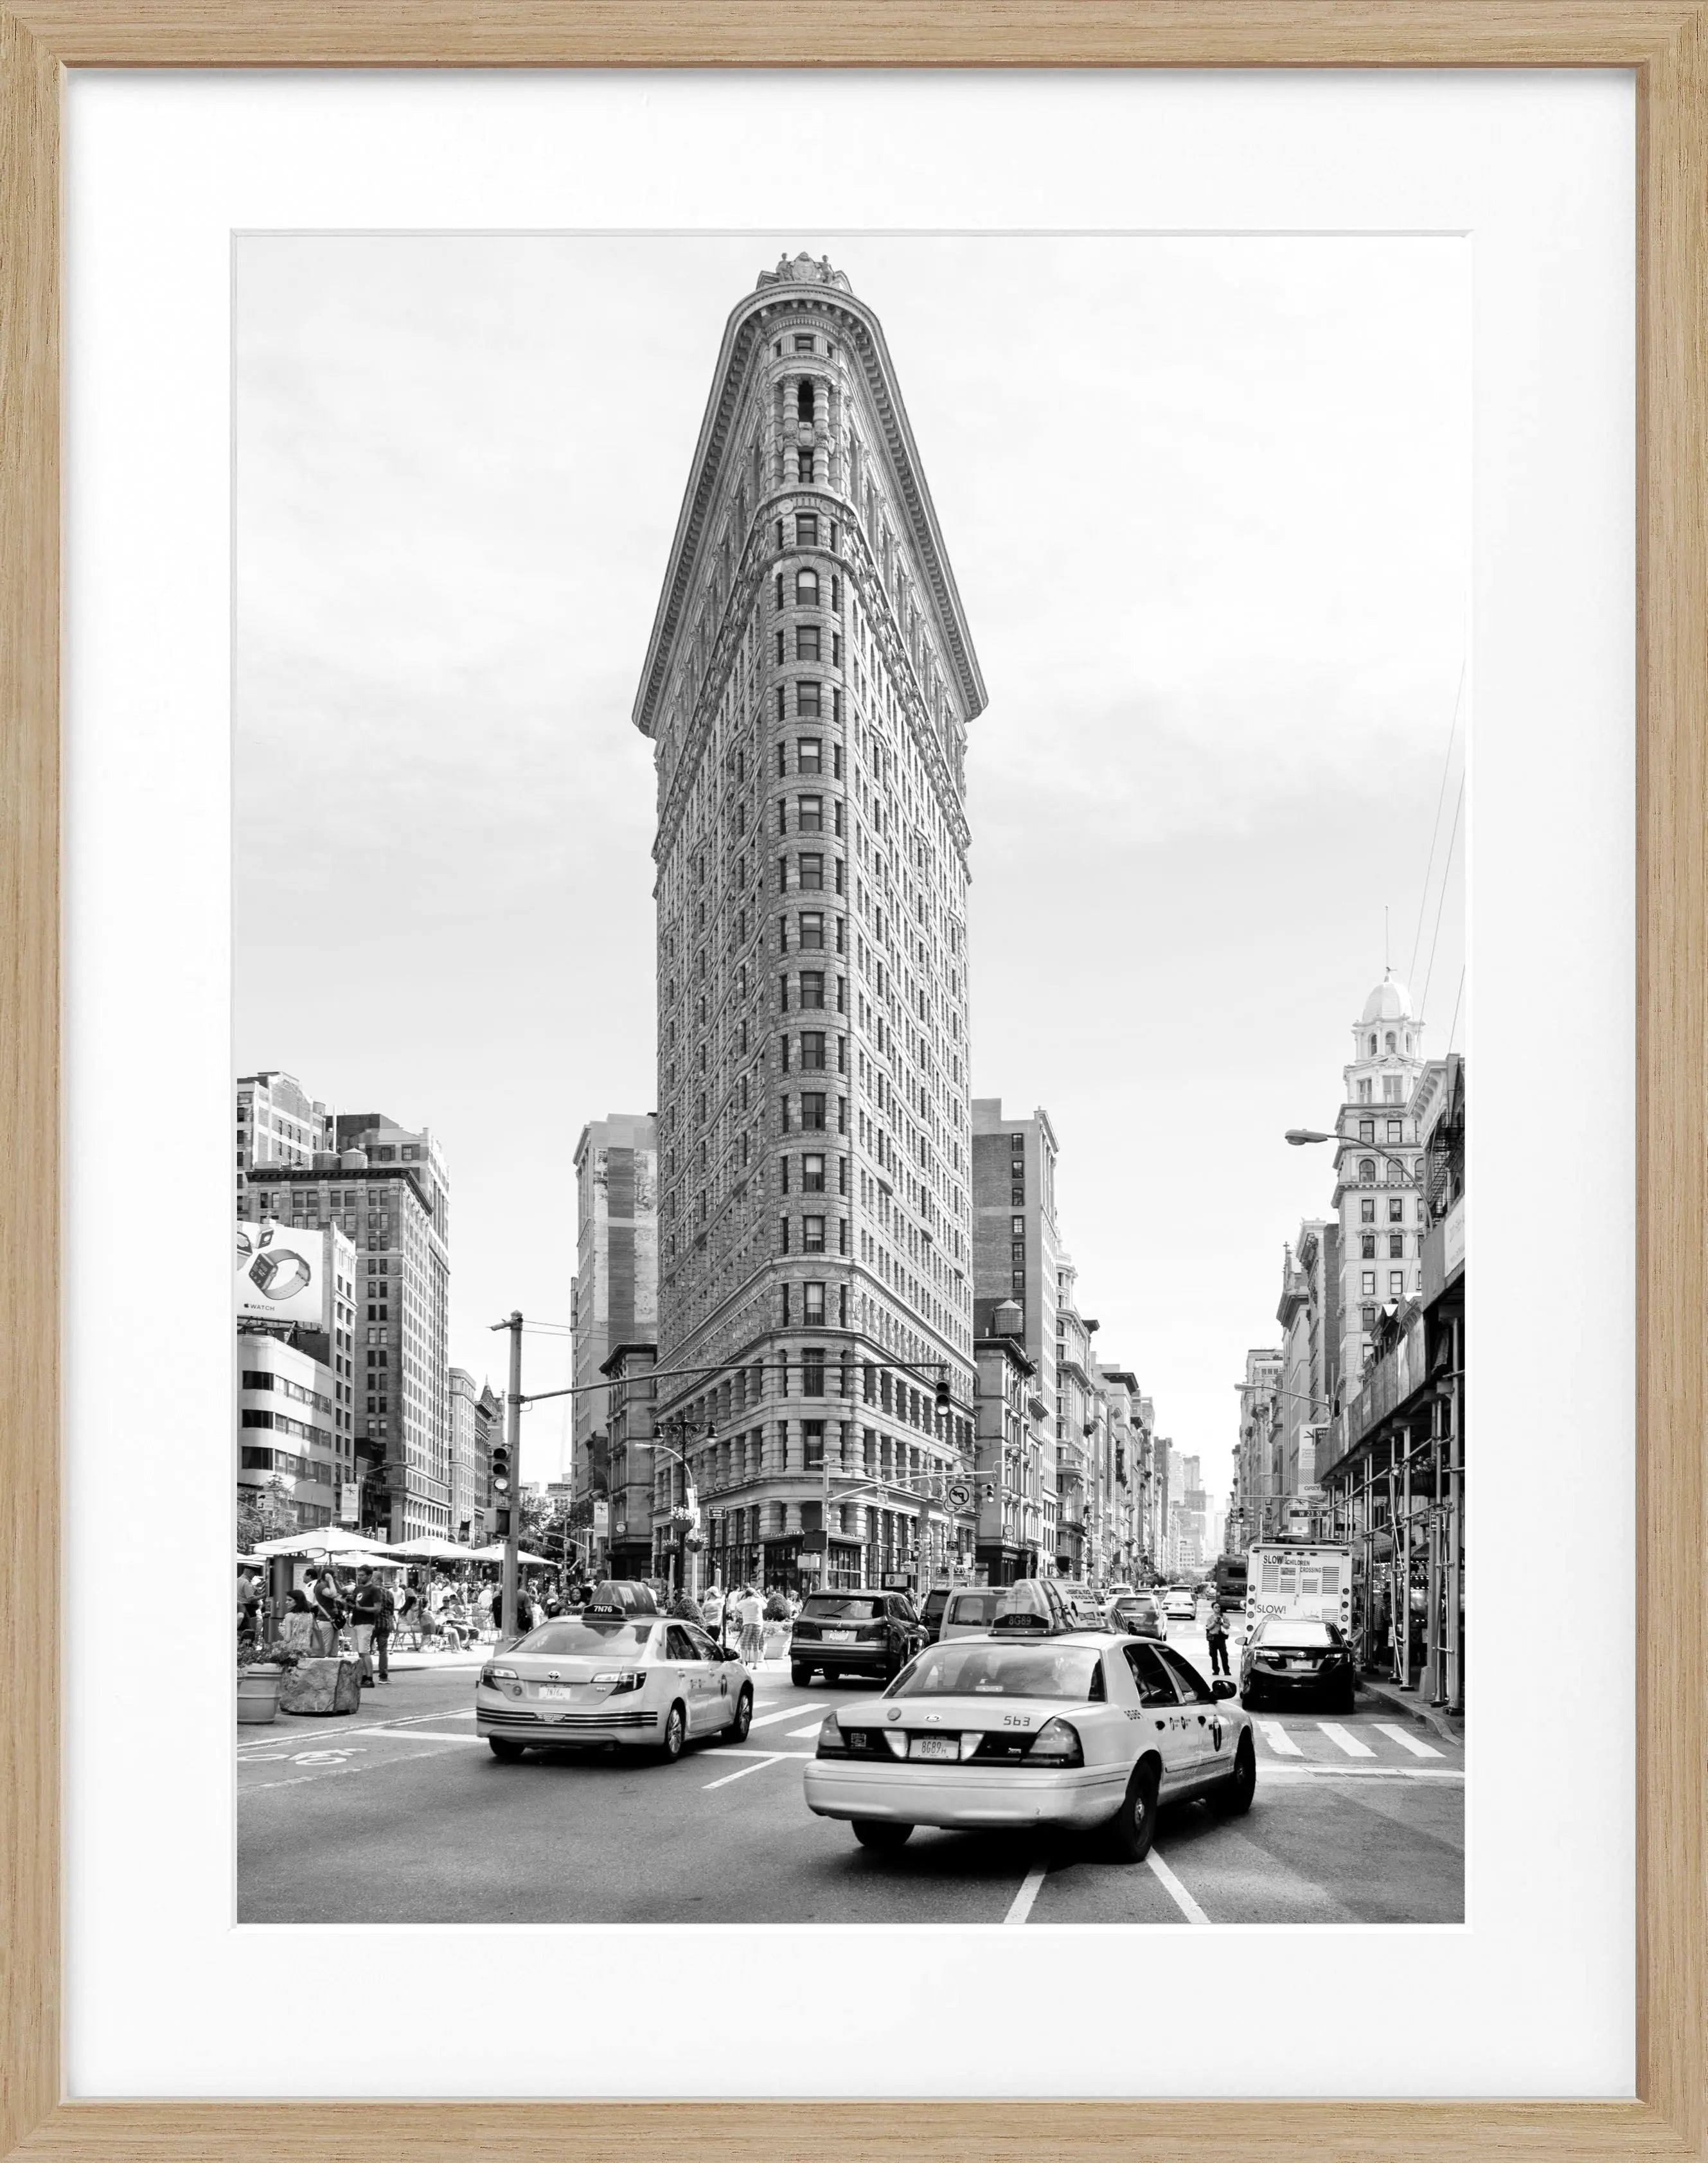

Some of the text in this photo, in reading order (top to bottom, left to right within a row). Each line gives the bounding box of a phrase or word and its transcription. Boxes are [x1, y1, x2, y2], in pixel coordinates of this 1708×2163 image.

[1257, 1605, 1286, 1614] SLOW!
[1009, 1616, 1031, 1625] 8G89
[1003, 1716, 1030, 1727] 563
